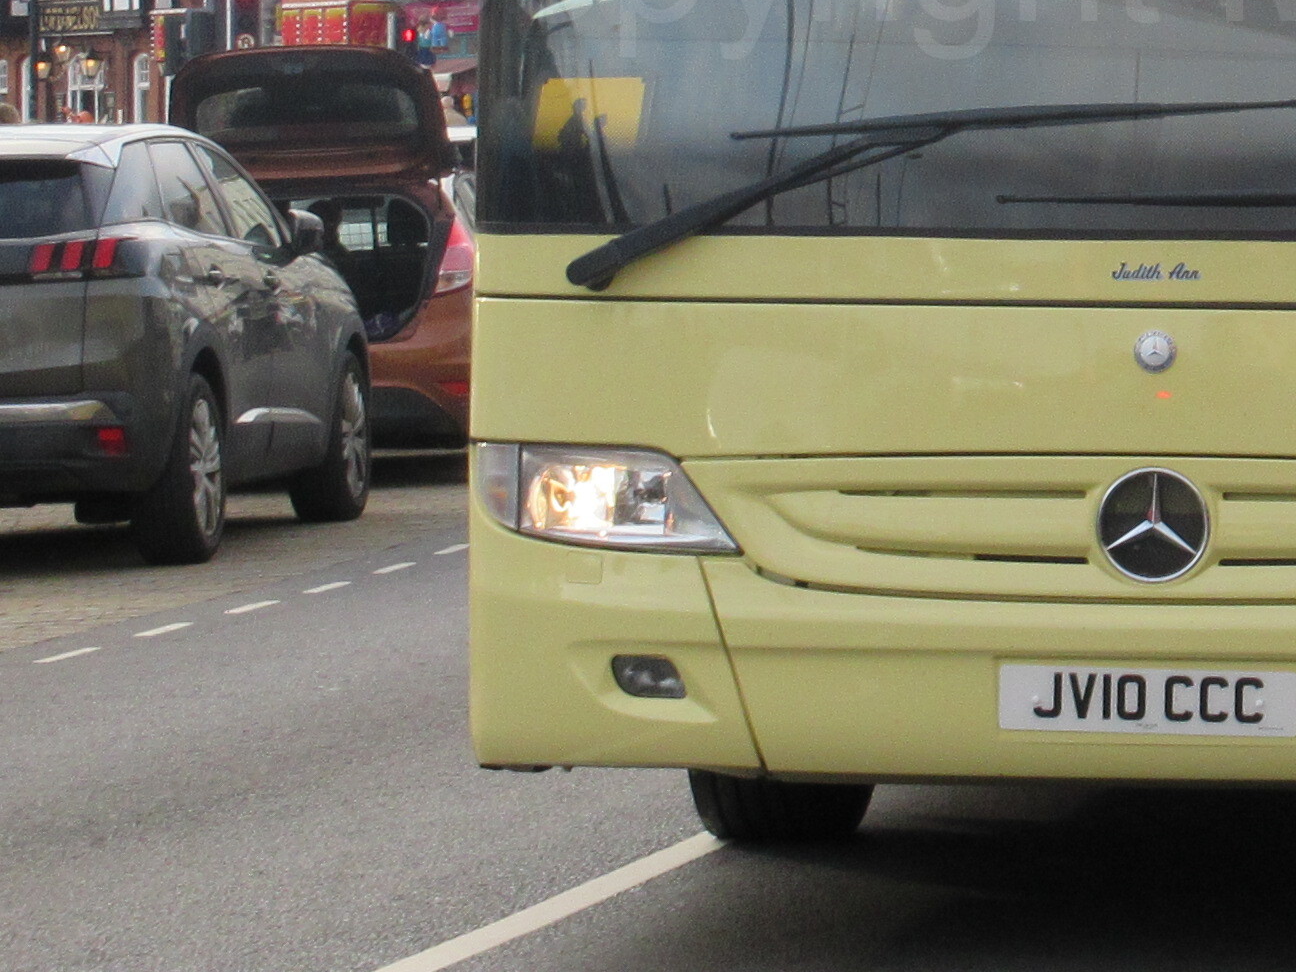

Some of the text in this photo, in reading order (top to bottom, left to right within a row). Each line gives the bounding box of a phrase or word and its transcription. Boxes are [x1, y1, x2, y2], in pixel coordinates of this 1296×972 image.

[1111, 262, 1200, 280] Judith Ann
[1033, 671, 1265, 724] JV10 CCC
